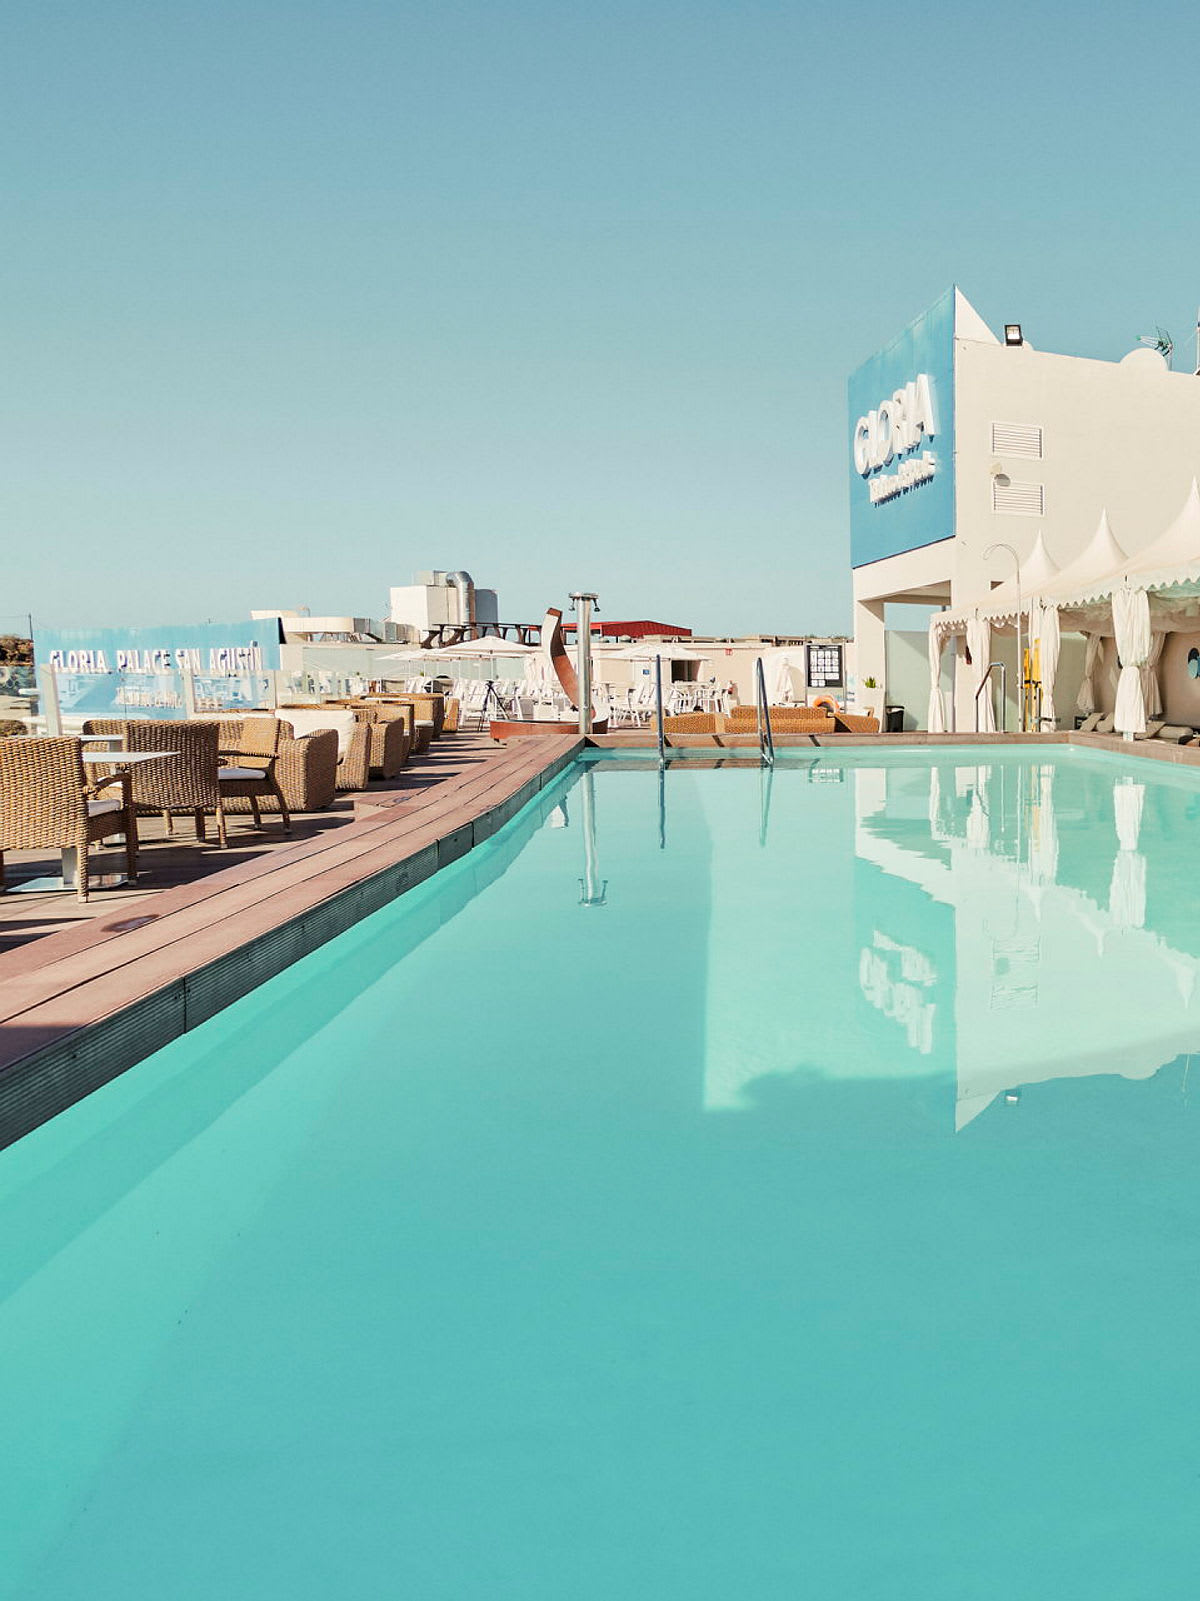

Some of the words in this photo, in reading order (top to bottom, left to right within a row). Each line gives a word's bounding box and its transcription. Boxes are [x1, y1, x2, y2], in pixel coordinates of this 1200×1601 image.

[854, 373, 938, 476] GLORIA
[50, 649, 107, 673] GLORIA
[116, 649, 172, 674] PALACE
[175, 648, 201, 675] SAN
